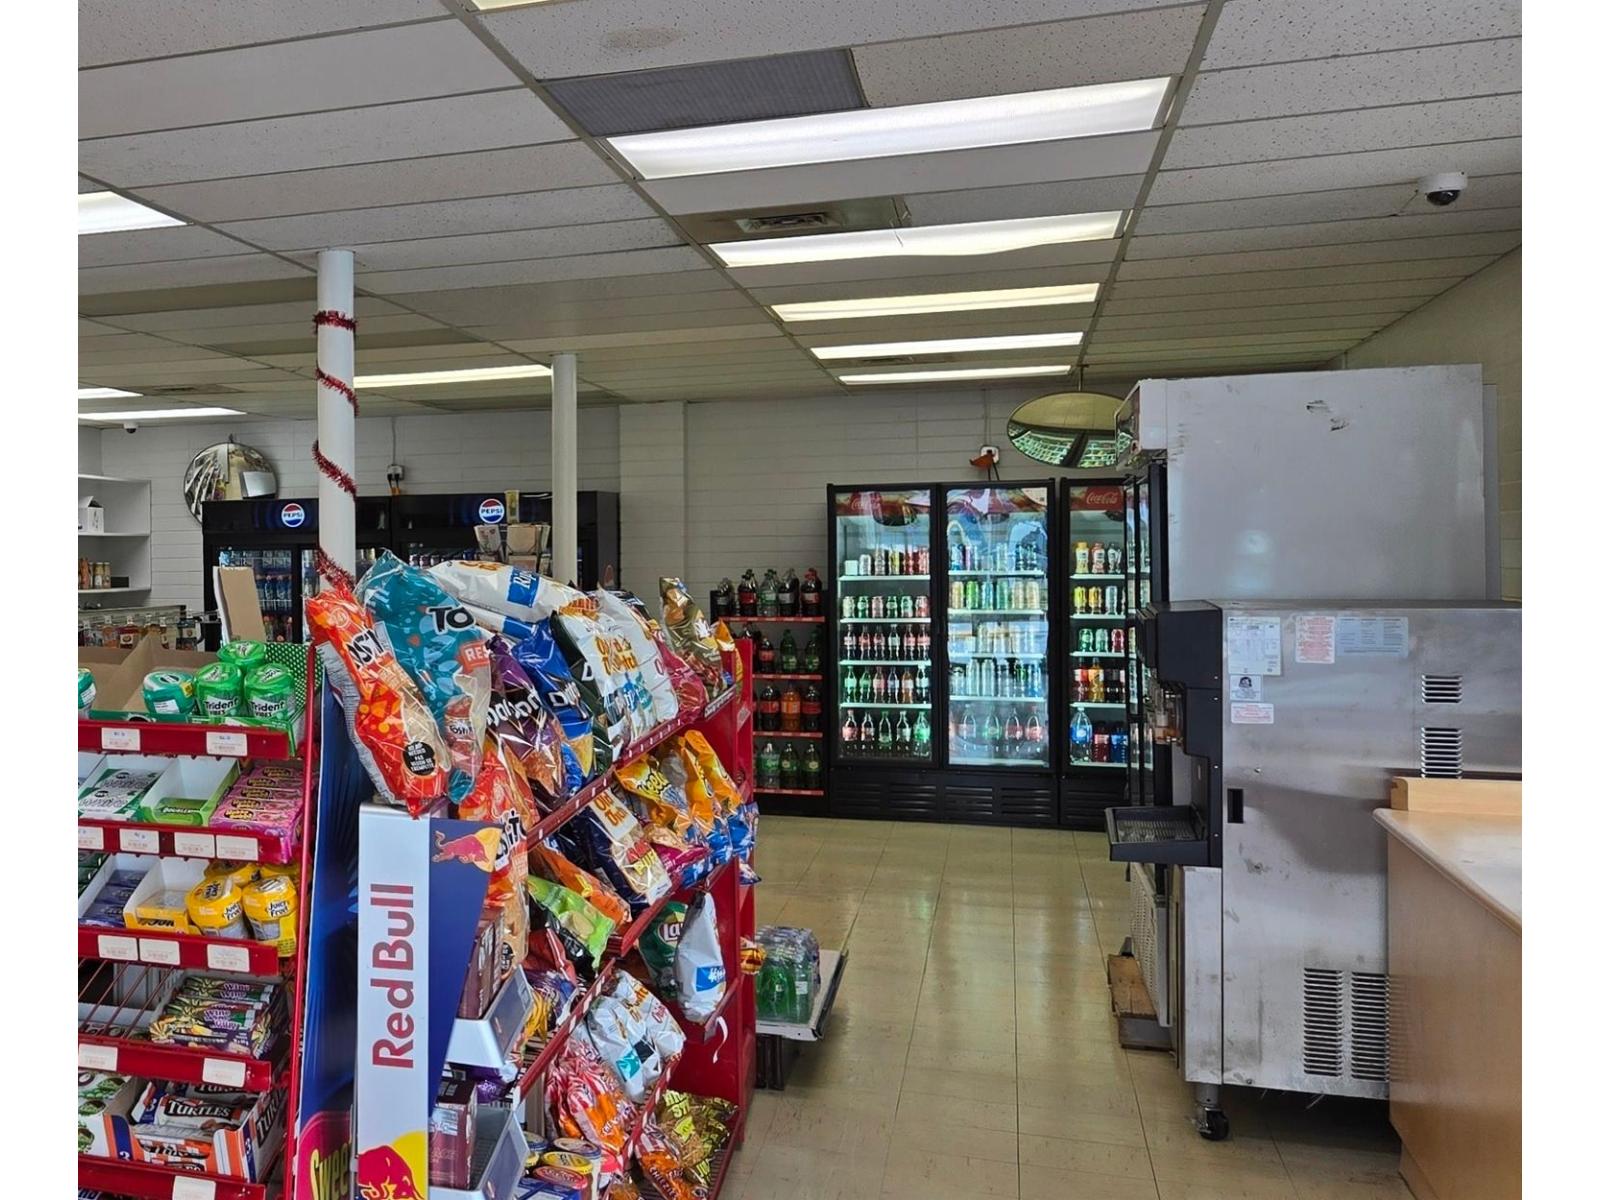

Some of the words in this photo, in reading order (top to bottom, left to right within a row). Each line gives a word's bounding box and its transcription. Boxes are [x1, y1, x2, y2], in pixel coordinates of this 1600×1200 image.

[205, 697, 238, 710] Trident
[250, 701, 286, 712] Trident
[370, 883, 415, 971] Bull
[663, 922, 684, 941] La
[370, 978, 415, 1069] Red
